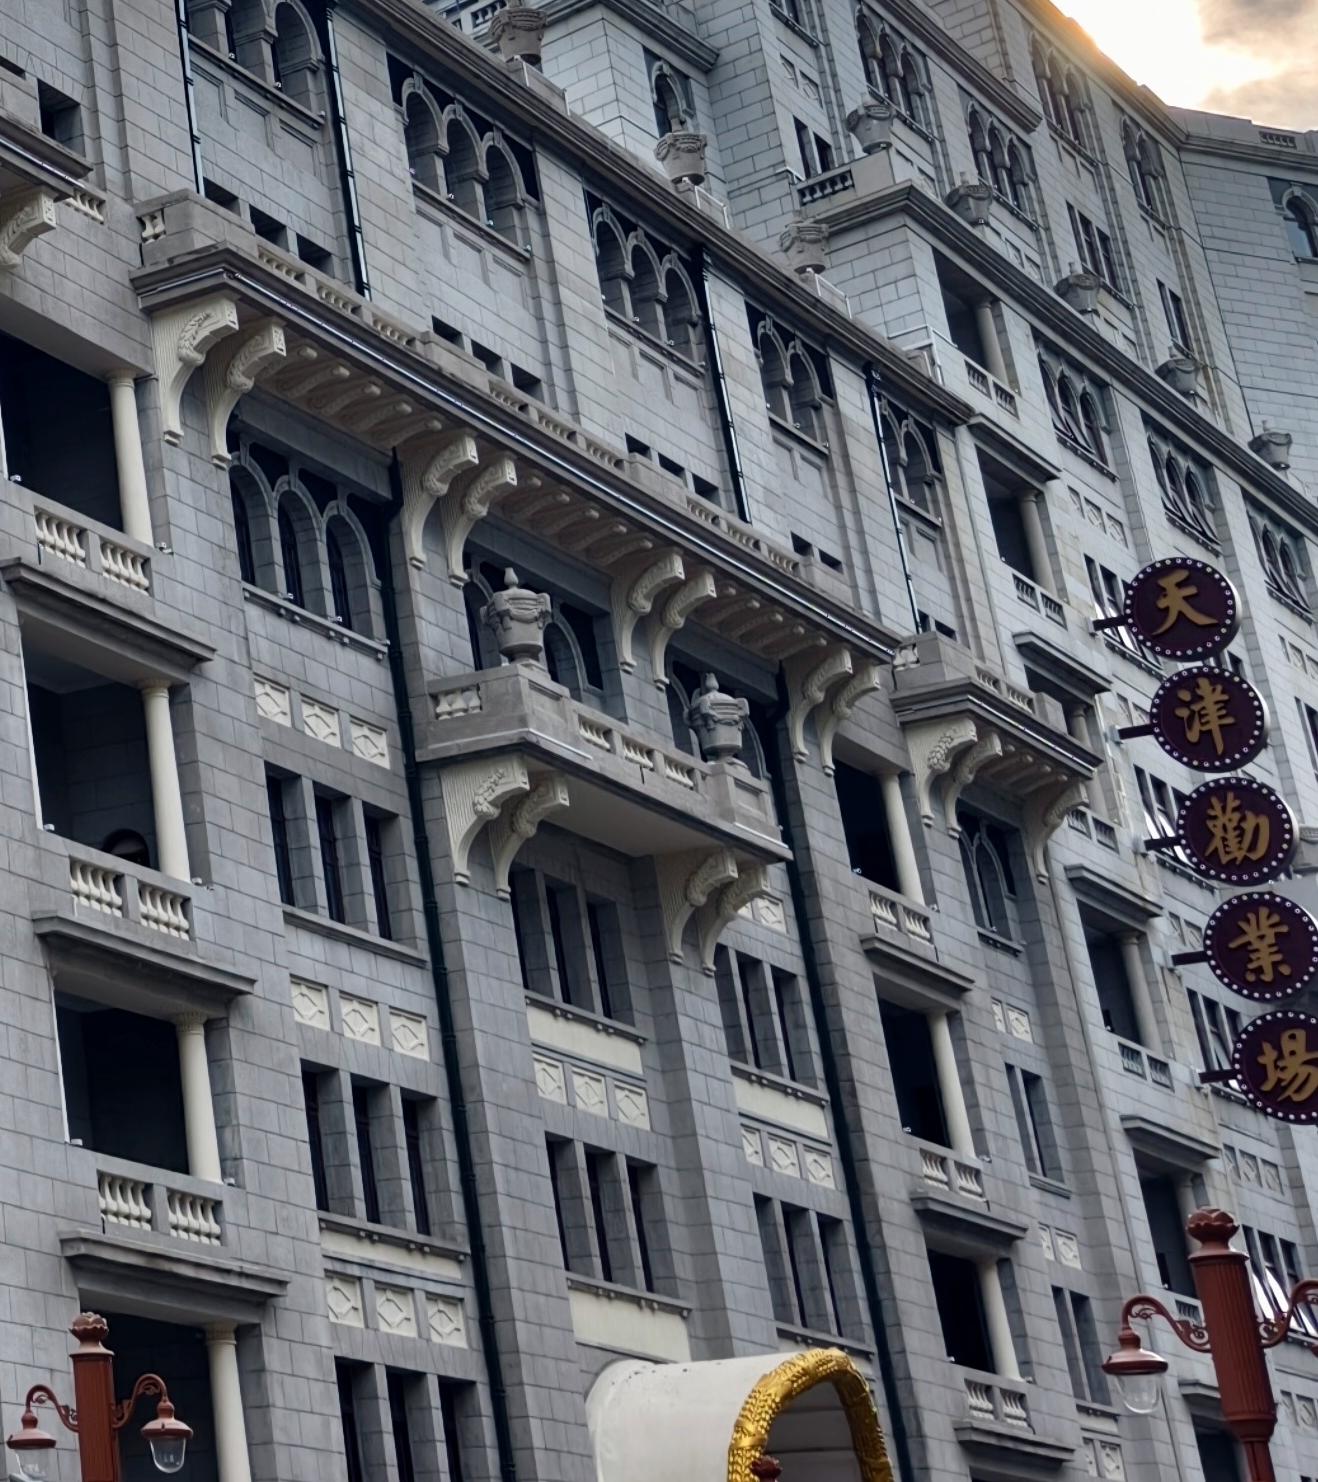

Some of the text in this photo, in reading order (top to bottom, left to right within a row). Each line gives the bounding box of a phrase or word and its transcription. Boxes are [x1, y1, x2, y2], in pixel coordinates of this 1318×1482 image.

[1152, 571, 1318, 1103] 天津勸業場
